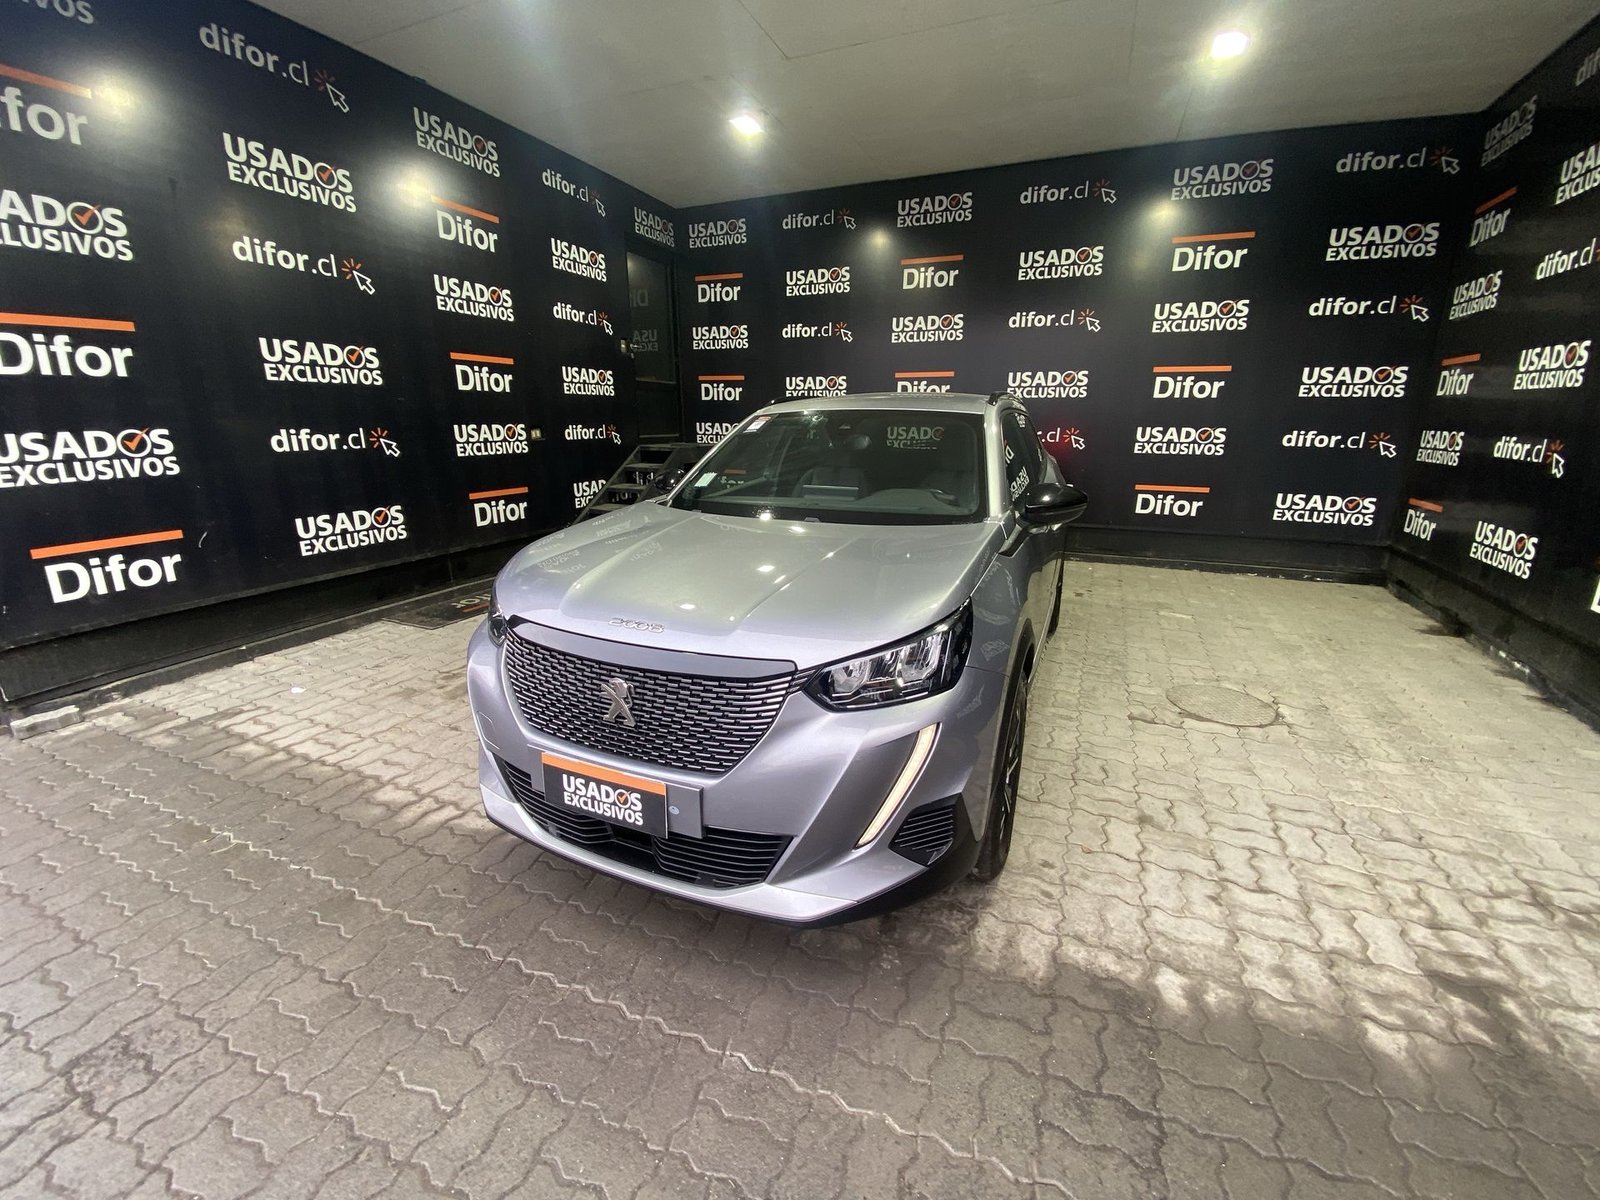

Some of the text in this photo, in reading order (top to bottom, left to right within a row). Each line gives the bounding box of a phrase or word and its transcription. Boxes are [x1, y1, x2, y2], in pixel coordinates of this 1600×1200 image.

[199, 23, 310, 86] difor.cl
[413, 106, 499, 162] USADOS
[222, 131, 354, 194] USADOS
[416, 131, 500, 178] EXCLUSIVOS
[1335, 147, 1427, 174] difor.cl
[1173, 159, 1274, 186] USADOS
[227, 160, 357, 213] EXCLUSIVOS
[542, 168, 589, 203] difor.cl
[1020, 181, 1089, 204] difor.cl
[1170, 178, 1272, 201] EXCLUSIVOS
[897, 191, 973, 216] USADOS
[634, 206, 674, 236] USADOS
[689, 218, 746, 238] USADOS
[782, 209, 834, 230] difor.cl
[897, 208, 973, 228] EXCLUSIVOS
[1469, 207, 1511, 248] Difor
[0, 222, 134, 262] LUSIVOS
[436, 208, 498, 253] Difor
[634, 222, 675, 248] EXCLUSIVOS
[689, 232, 747, 249] EXCLUSIVOS
[1329, 222, 1440, 247] USADOS
[232, 235, 338, 278] difor.cl
[550, 237, 606, 270] USADOS
[1019, 245, 1104, 268] USADOS
[1172, 245, 1248, 272] Difor
[1325, 242, 1437, 262] EXCLUSIVOS
[1536, 238, 1596, 280] difor.cl
[552, 255, 607, 282] EXCLUSIVOS
[786, 266, 850, 286] USADOS
[902, 266, 959, 290] Difor
[1018, 263, 1103, 281] EXCLUSIVOS
[433, 273, 513, 308] USADOS
[697, 283, 741, 303] Difor
[786, 281, 850, 297] EXCLUSIVOS
[1453, 270, 1503, 306] USADOS
[436, 295, 514, 322] EXCLUSIVOS
[552, 302, 597, 326] difor.cl
[1008, 309, 1075, 328] difor.cl
[1154, 299, 1250, 320] USADOS
[1308, 296, 1397, 317] difor.cl
[1450, 293, 1498, 321] EXCLUSIVOS
[692, 324, 748, 341] USADOS
[782, 322, 832, 338] difor.cl
[891, 313, 964, 332] USADOS
[1151, 317, 1248, 333] EXCLUSIVOS
[692, 338, 749, 350] EXCLUSIVOS
[891, 328, 963, 343] EXCLUSIVOS
[0, 332, 134, 378] Difor
[258, 336, 380, 370] USADOS
[1518, 339, 1592, 372] USADOS
[263, 363, 384, 386] EXCLUSIVOS
[454, 363, 514, 393] Difor
[562, 365, 613, 386] USADOS
[785, 375, 847, 391] USADOS
[1007, 370, 1089, 387] USADOS
[1301, 366, 1409, 385] USADOS
[1436, 369, 1474, 396] Difor
[1513, 368, 1585, 391] EXCLUSIVOS
[563, 382, 615, 397] EXCLUSIVOS
[700, 382, 743, 401] Difor
[1153, 375, 1225, 399] Difor
[1298, 384, 1405, 398] EXCLUSIVOS
[270, 428, 366, 453] difor.cl
[453, 423, 527, 443] USADOS
[564, 424, 606, 441] difor.cl
[1135, 426, 1227, 444] USADOS
[1281, 430, 1366, 449] difor.cl
[1420, 430, 1465, 451] USADOS
[455, 441, 529, 457] EXCLUSIVOS
[1133, 442, 1225, 456] EXCLUSIVOS
[1416, 449, 1460, 467] EXCLUSIVOS
[1493, 436, 1547, 463] difor.cl
[473, 499, 528, 527] Difor
[1135, 492, 1203, 517] Difor
[1275, 493, 1377, 515] USADOS
[294, 504, 405, 540] USADOS
[1272, 509, 1374, 526] EXCLUSIVOS
[1403, 508, 1437, 542] Difor
[299, 523, 408, 557] EXCLUSIVOS
[1474, 520, 1538, 561] USADOS
[1469, 541, 1532, 580] EXCLUSIVOS
[44, 554, 182, 604] Difor
[608, 617, 665, 633] 2008
[562, 773, 643, 811] USADOS
[563, 792, 644, 826] EXCLUSIVOS
